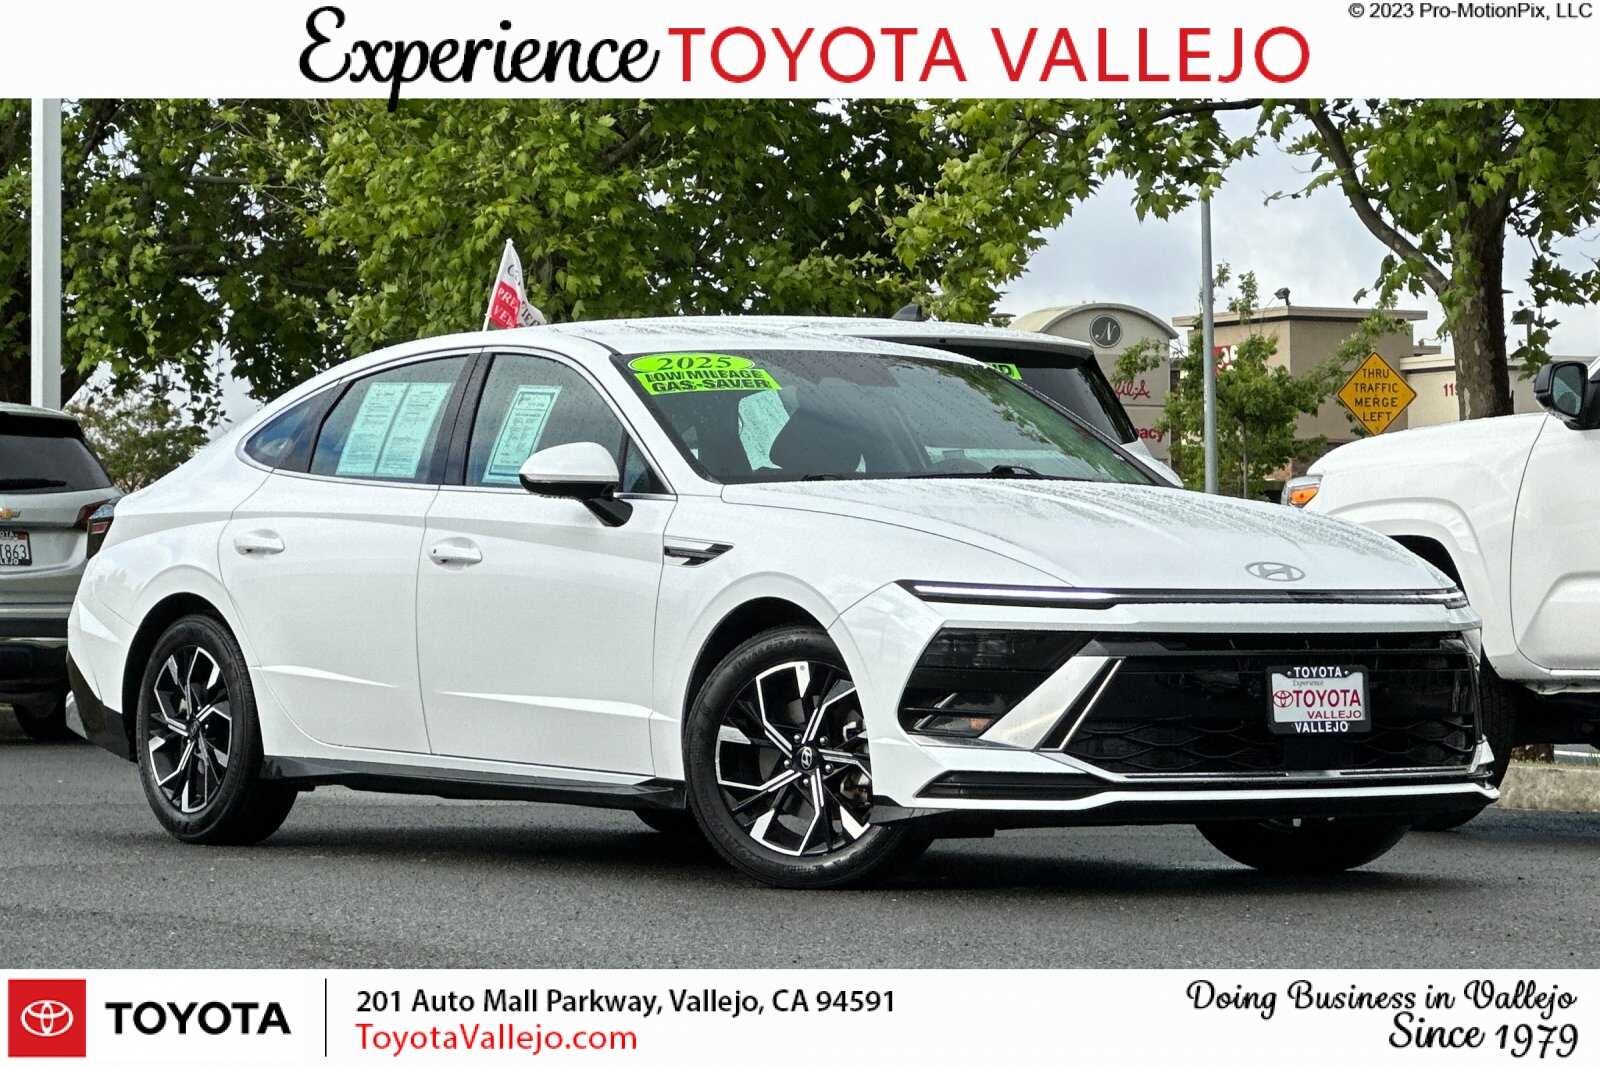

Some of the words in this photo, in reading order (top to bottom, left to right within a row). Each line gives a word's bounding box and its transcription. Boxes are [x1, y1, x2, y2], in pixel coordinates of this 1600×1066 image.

[657, 356, 732, 371] 2025
[645, 371, 685, 383] LOW
[689, 369, 763, 381] MILEAGE
[1362, 368, 1390, 379] THRU
[1354, 383, 1400, 393] TRAFFIC
[1443, 383, 1457, 397] 11
[1354, 397, 1398, 408] MERGE
[1362, 411, 1392, 422] LEFT
[1293, 666, 1343, 678] TOYOTA
[1293, 688, 1361, 707] TOYOTA
[1307, 710, 1362, 719] VALLEJO
[1294, 720, 1349, 733] VALLEJO
